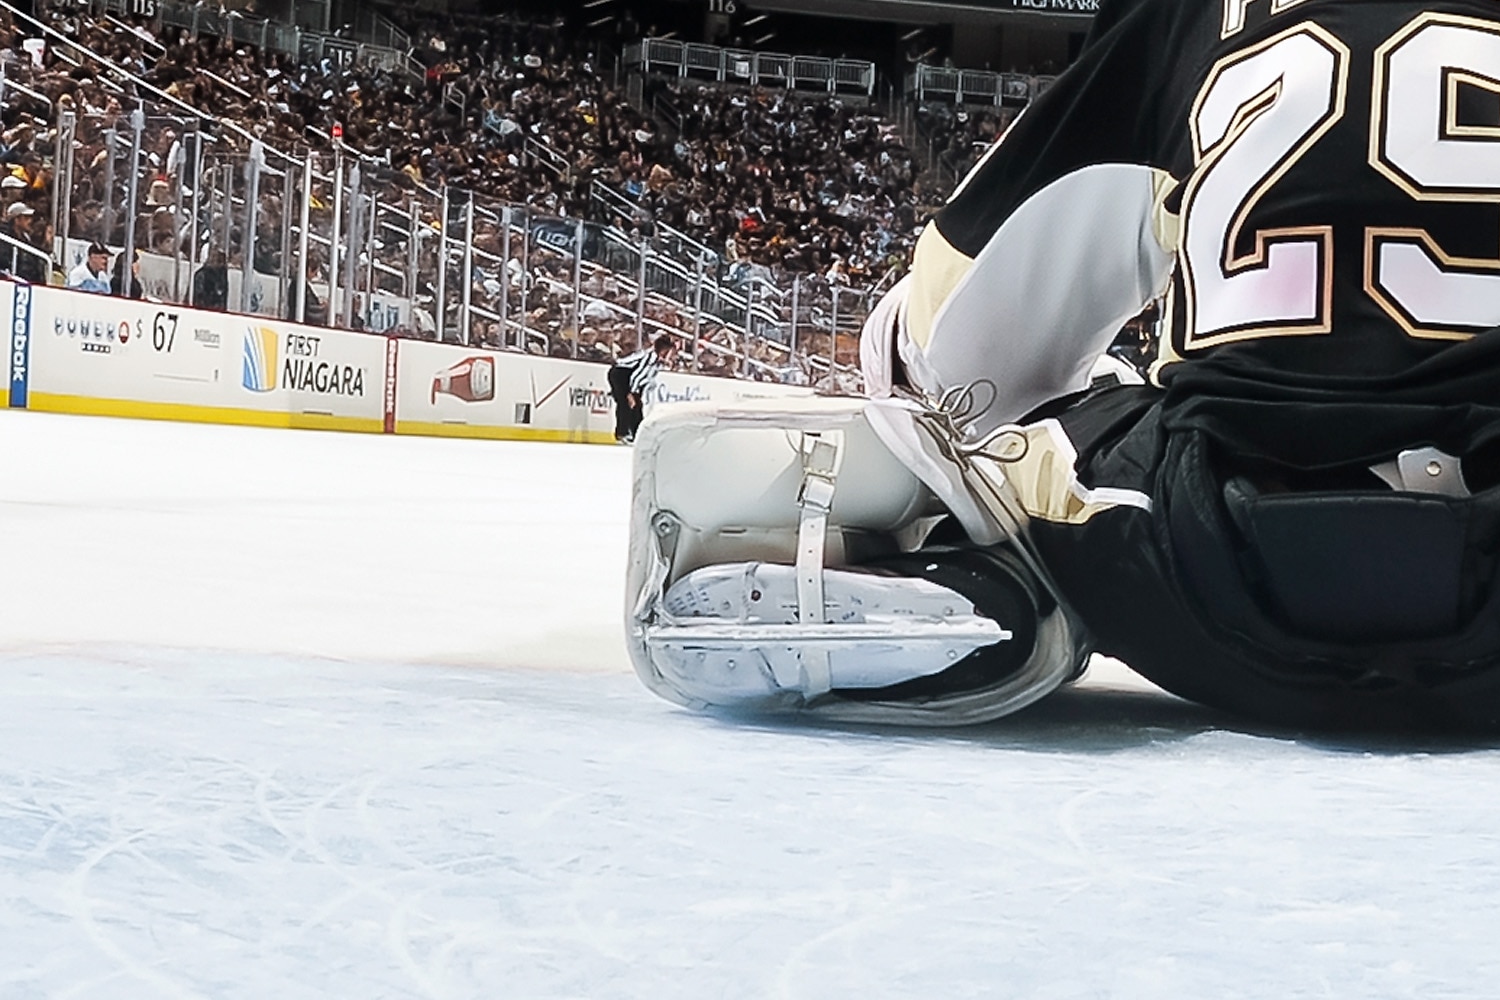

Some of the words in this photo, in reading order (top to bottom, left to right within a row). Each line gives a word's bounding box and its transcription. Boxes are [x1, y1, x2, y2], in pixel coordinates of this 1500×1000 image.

[12, 284, 31, 383] Reebok
[152, 311, 179, 353] 67
[285, 333, 321, 356] FIRST
[282, 358, 364, 397] NIAGARA
